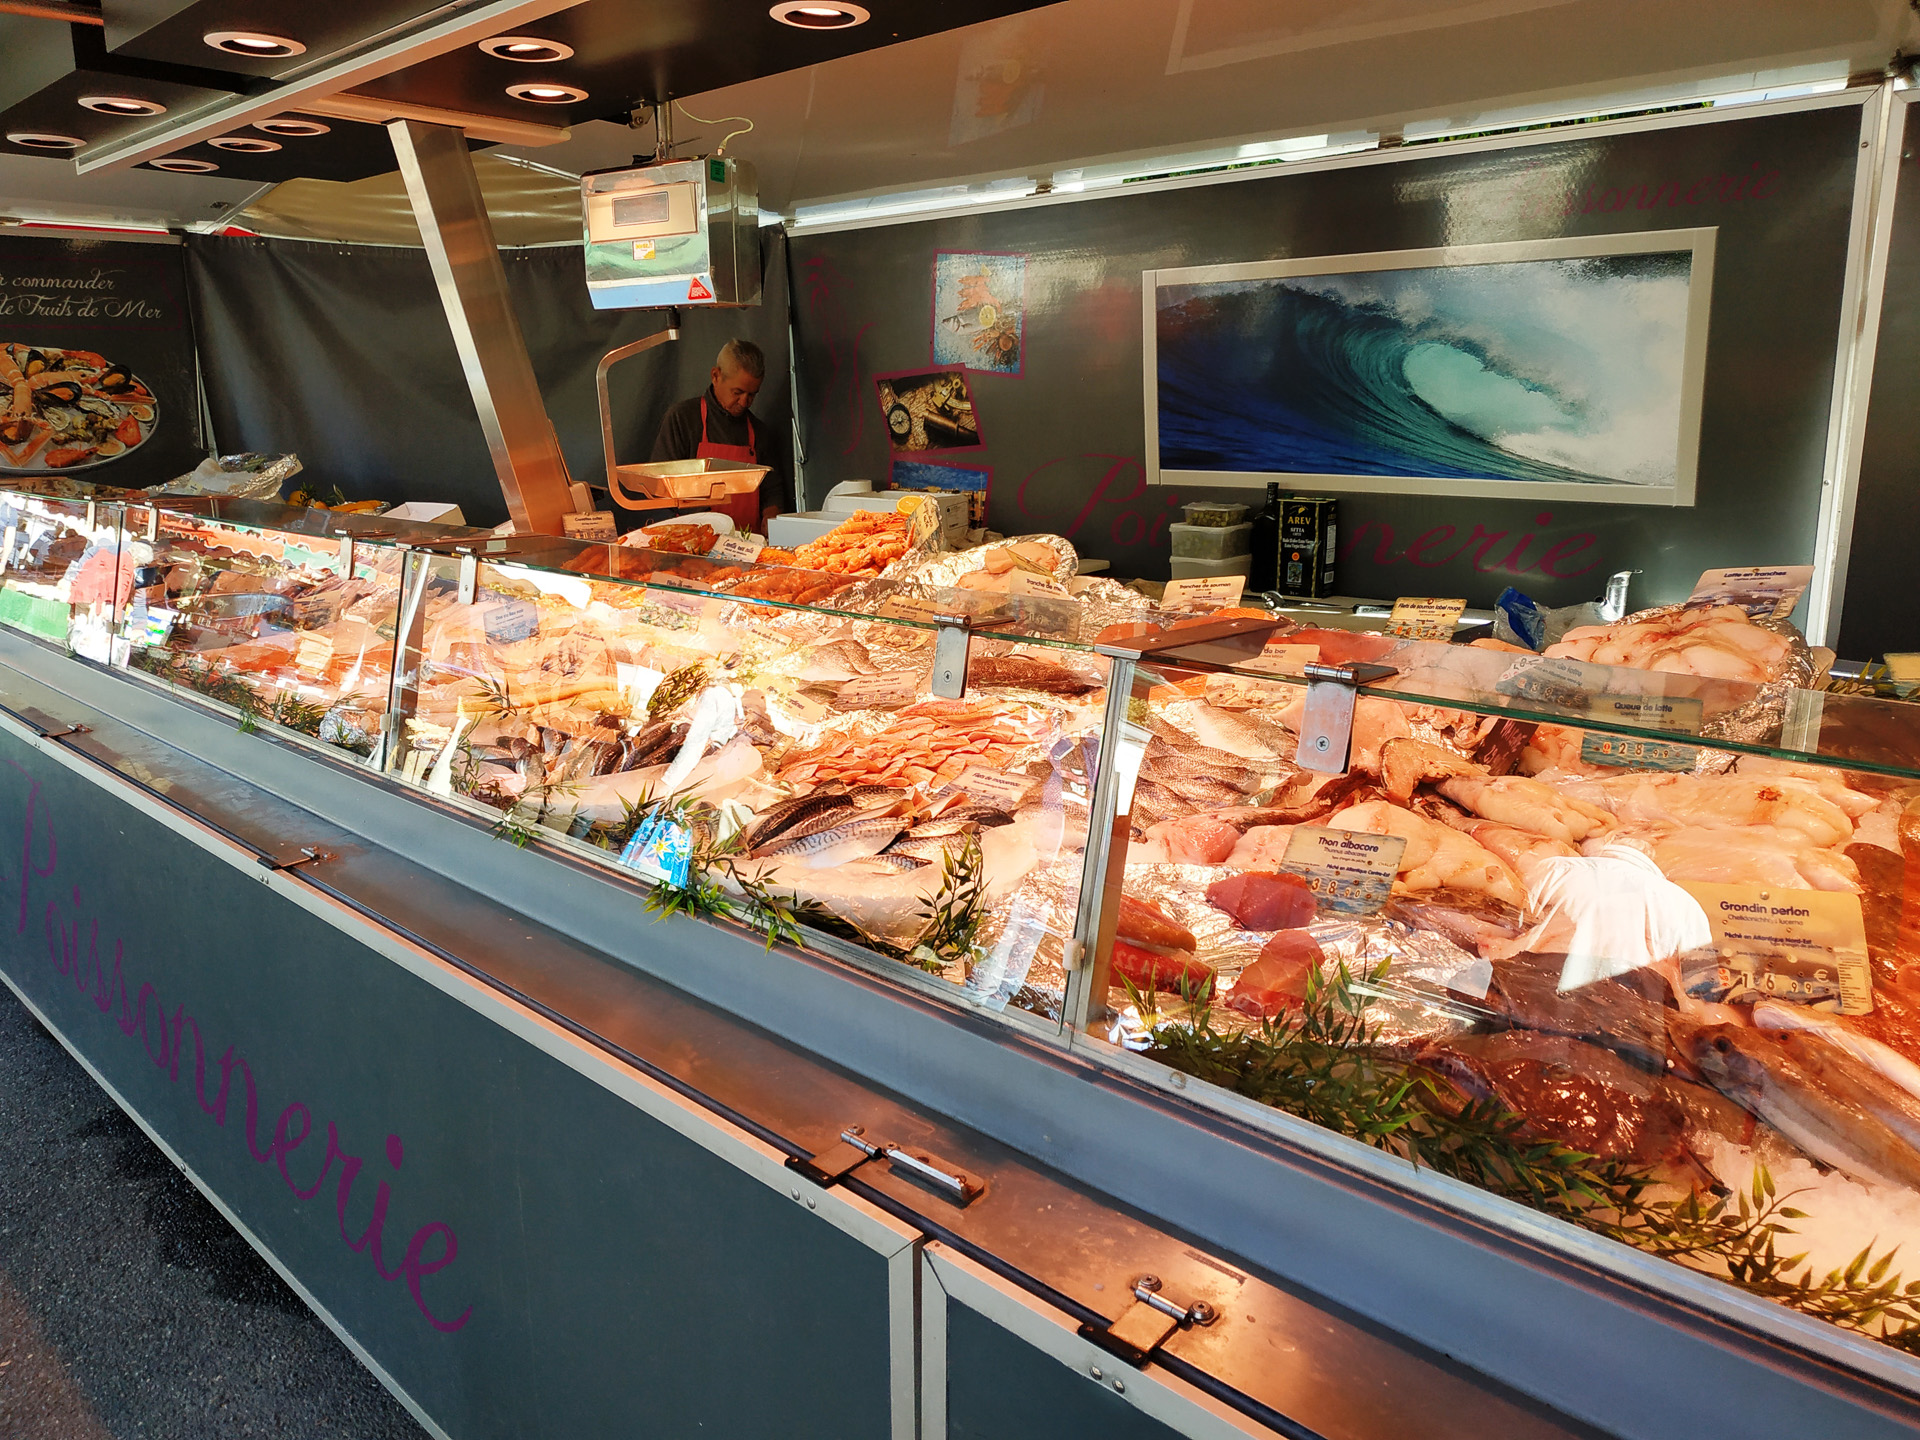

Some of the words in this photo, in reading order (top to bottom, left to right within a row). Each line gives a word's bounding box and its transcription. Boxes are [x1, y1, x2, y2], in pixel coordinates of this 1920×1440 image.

[12, 268, 127, 290] commander
[18, 294, 76, 317] Fruits
[77, 297, 102, 317] de
[104, 300, 164, 319] Mer
[1016, 453, 1602, 580] Poinerie
[1287, 516, 1311, 525] AREV
[1026, 578, 1045, 588] Tranche
[1614, 702, 1641, 710] Queue
[1643, 702, 1653, 711] de
[1655, 704, 1673, 712] lotte
[1318, 836, 1339, 847] Thon
[1341, 840, 1379, 852] albacore
[1324, 847, 1343, 855] Thunnus
[1346, 866, 1367, 874] Atlantique
[1720, 901, 1767, 914] Grondin
[1771, 906, 1810, 917] perlon
[1779, 918, 1804, 926] lucerna
[1753, 935, 1784, 943] Atlantique
[1785, 937, 1812, 945] Nord-Est
[1813, 969, 1829, 983] €
[0, 757, 474, 1333] Poissonnerie
